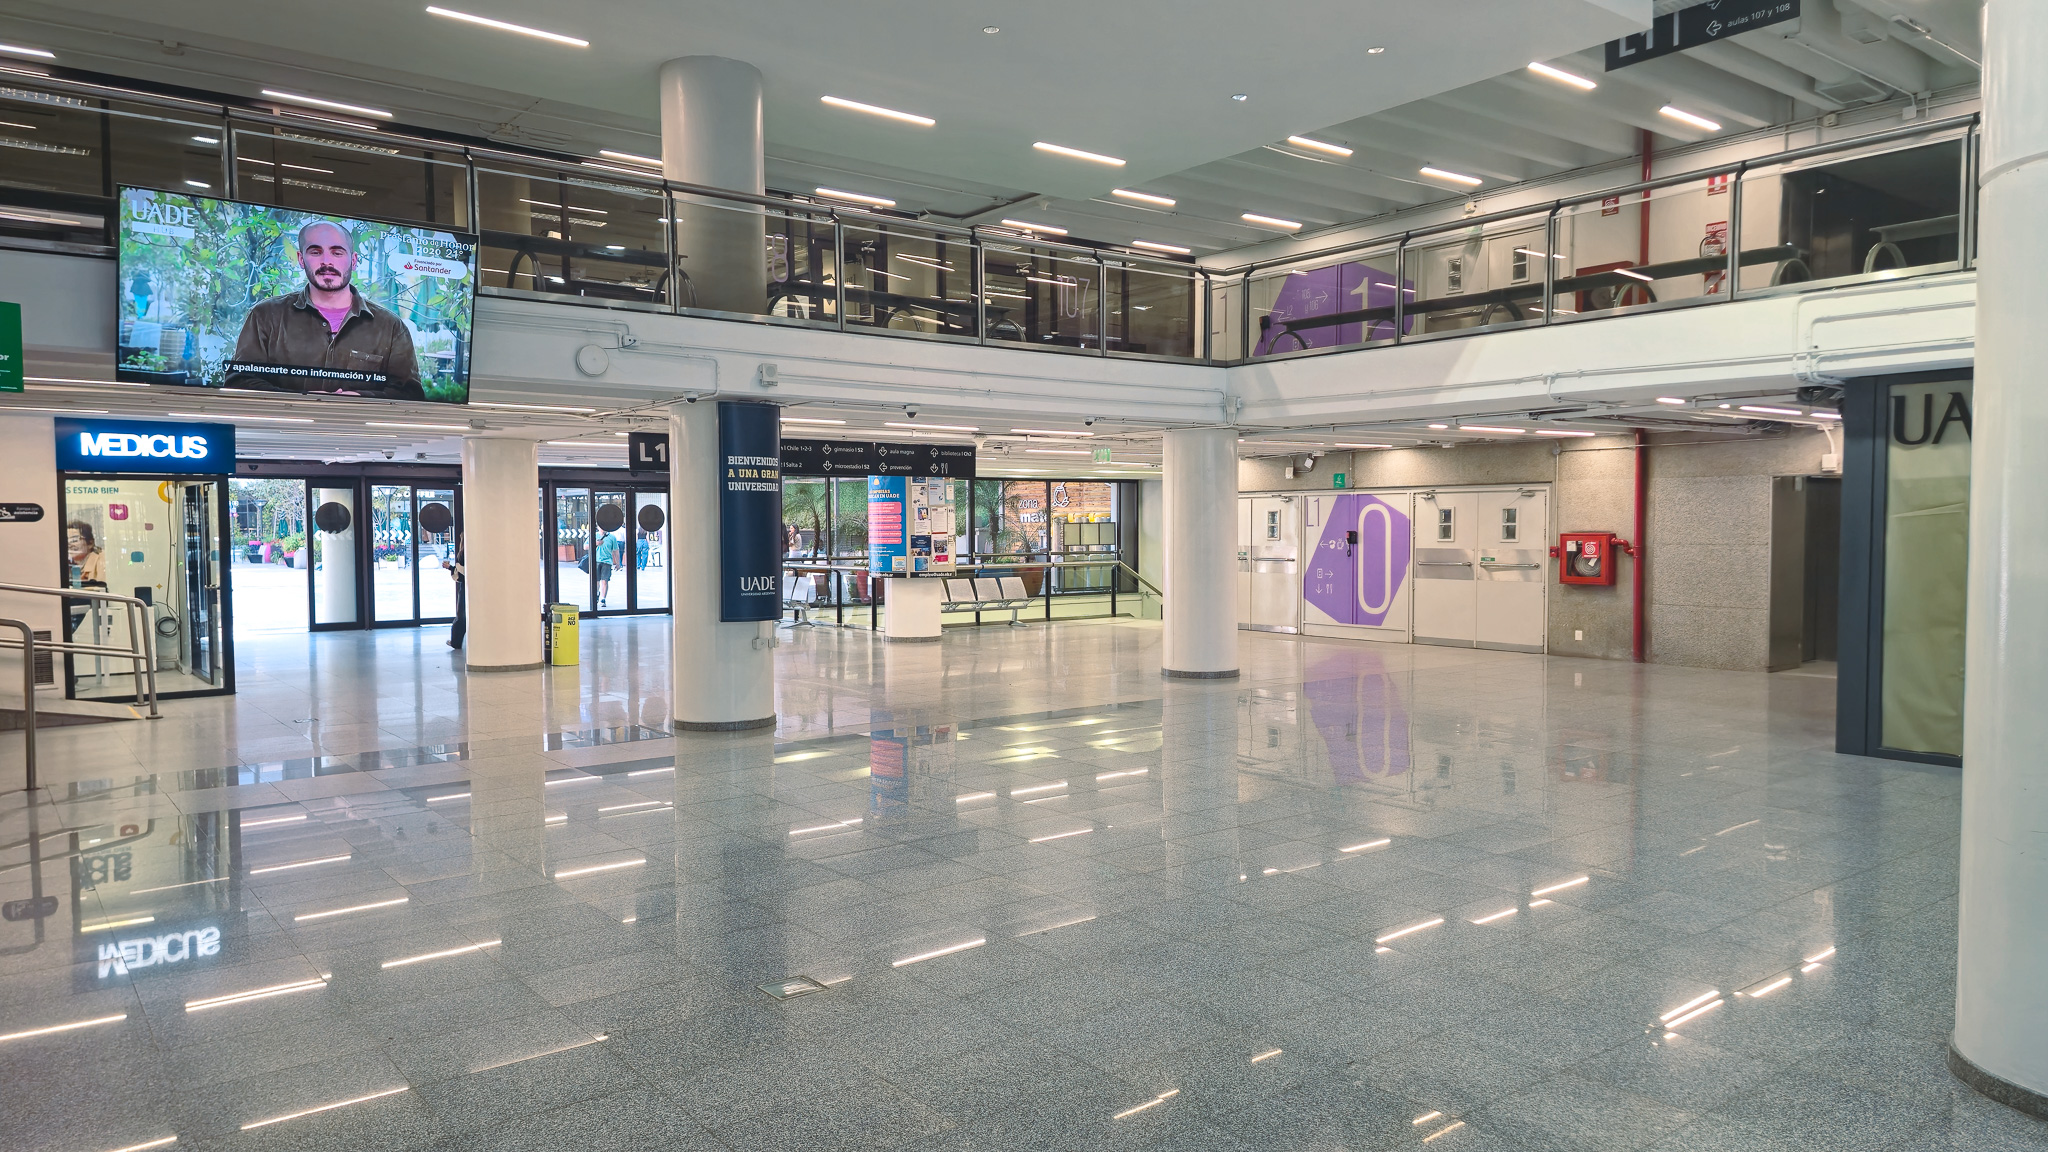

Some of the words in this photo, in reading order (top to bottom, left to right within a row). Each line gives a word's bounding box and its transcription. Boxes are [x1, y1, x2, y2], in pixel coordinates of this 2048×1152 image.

[1727, 15, 1749, 28] aulas
[1751, 10, 1766, 21] 107
[1767, 10, 1773, 18] y
[1775, 3, 1791, 13] 108
[131, 200, 195, 227] UADE
[153, 227, 175, 235] HUB
[440, 240, 475, 252] Honor
[414, 264, 452, 275] Santander
[224, 362, 231, 371] y
[233, 363, 289, 375] apalancarte
[291, 368, 308, 376] con
[310, 368, 364, 380] información
[366, 373, 372, 382] y
[373, 373, 387, 382] las
[80, 432, 208, 459] MEDICUS
[833, 446, 855, 454] gimnasio
[639, 442, 666, 462] L1
[727, 455, 779, 467] BIENVENIDOS
[727, 468, 736, 478] A
[738, 469, 759, 479] UNA
[761, 471, 779, 479] GRAN
[73, 486, 99, 494] ESTAR
[101, 487, 119, 495] BIEN
[727, 481, 779, 492] UNIVERSIDAD
[1018, 499, 1039, 509] zona
[740, 575, 776, 591] UADE
